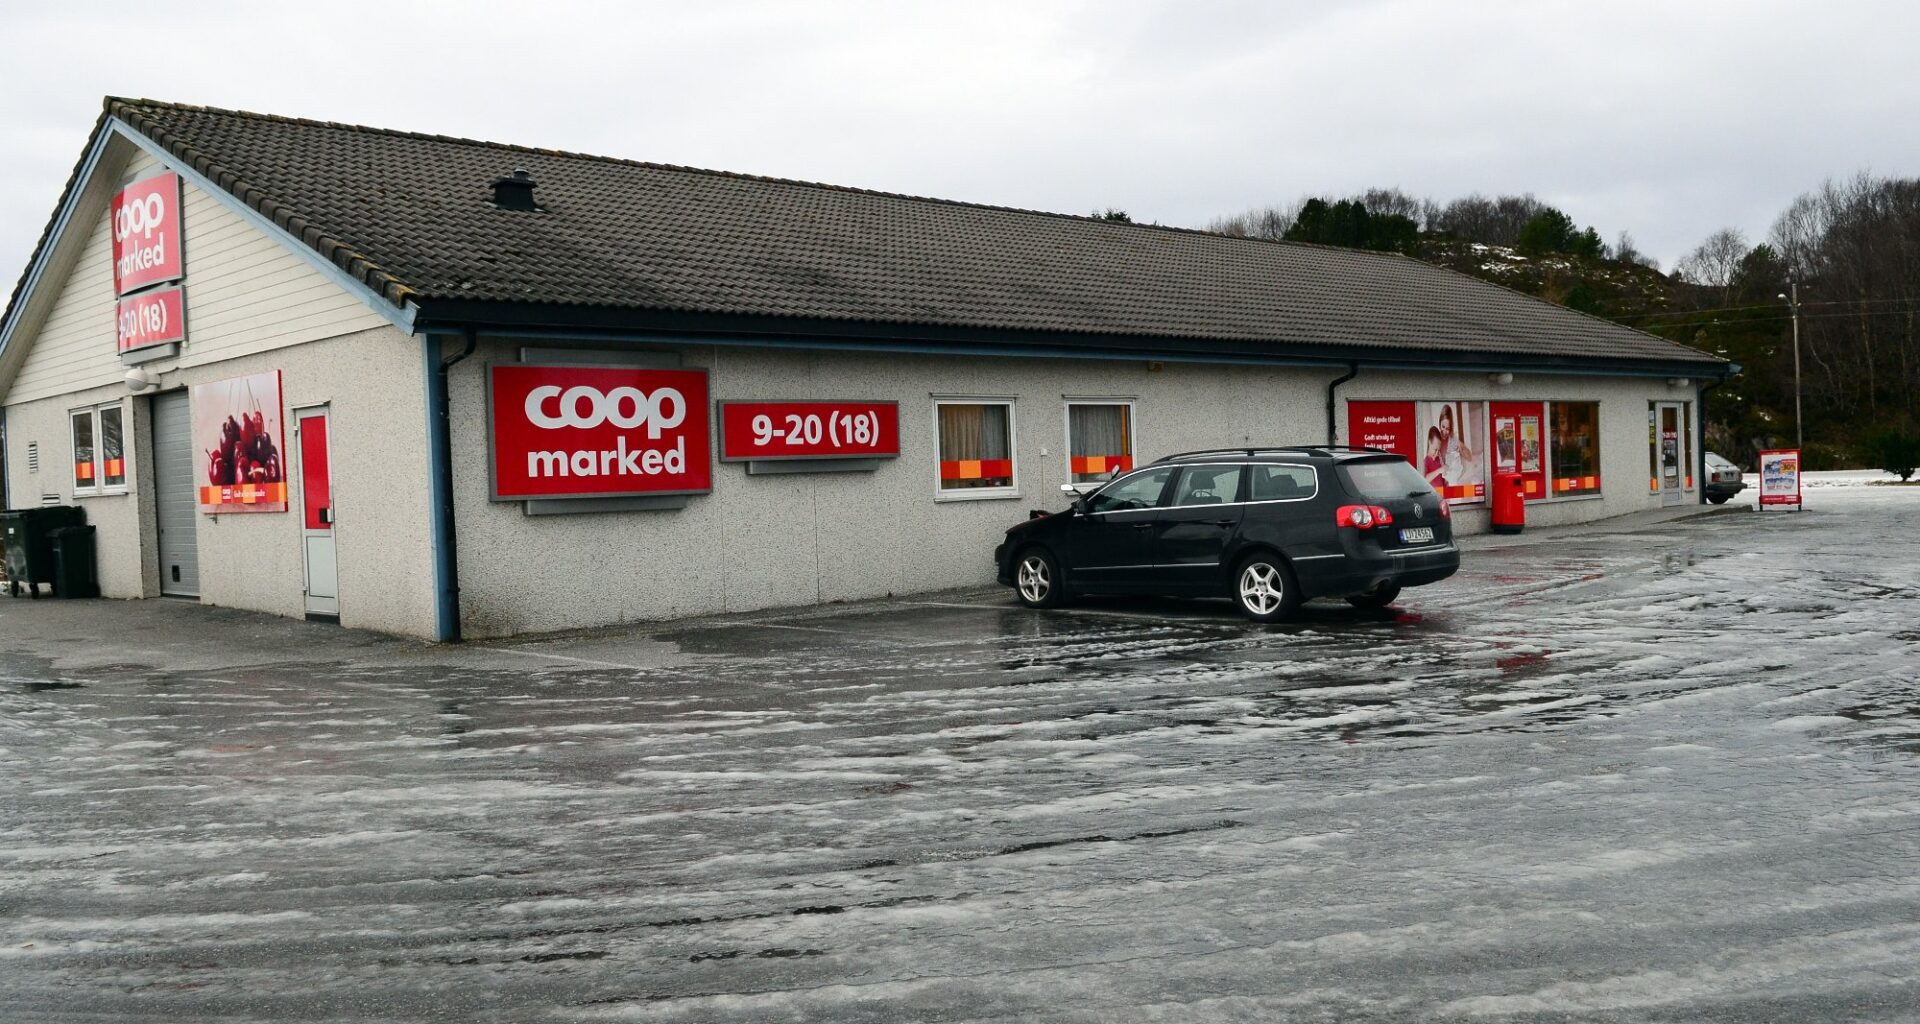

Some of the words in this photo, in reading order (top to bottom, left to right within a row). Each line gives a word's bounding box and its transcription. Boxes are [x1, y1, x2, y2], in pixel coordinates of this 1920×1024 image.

[115, 193, 164, 243] coop
[139, 299, 167, 337] (18)
[525, 386, 686, 439] coop
[752, 414, 823, 446] 9-20
[829, 411, 879, 448] (18)
[528, 436, 686, 477] marked
